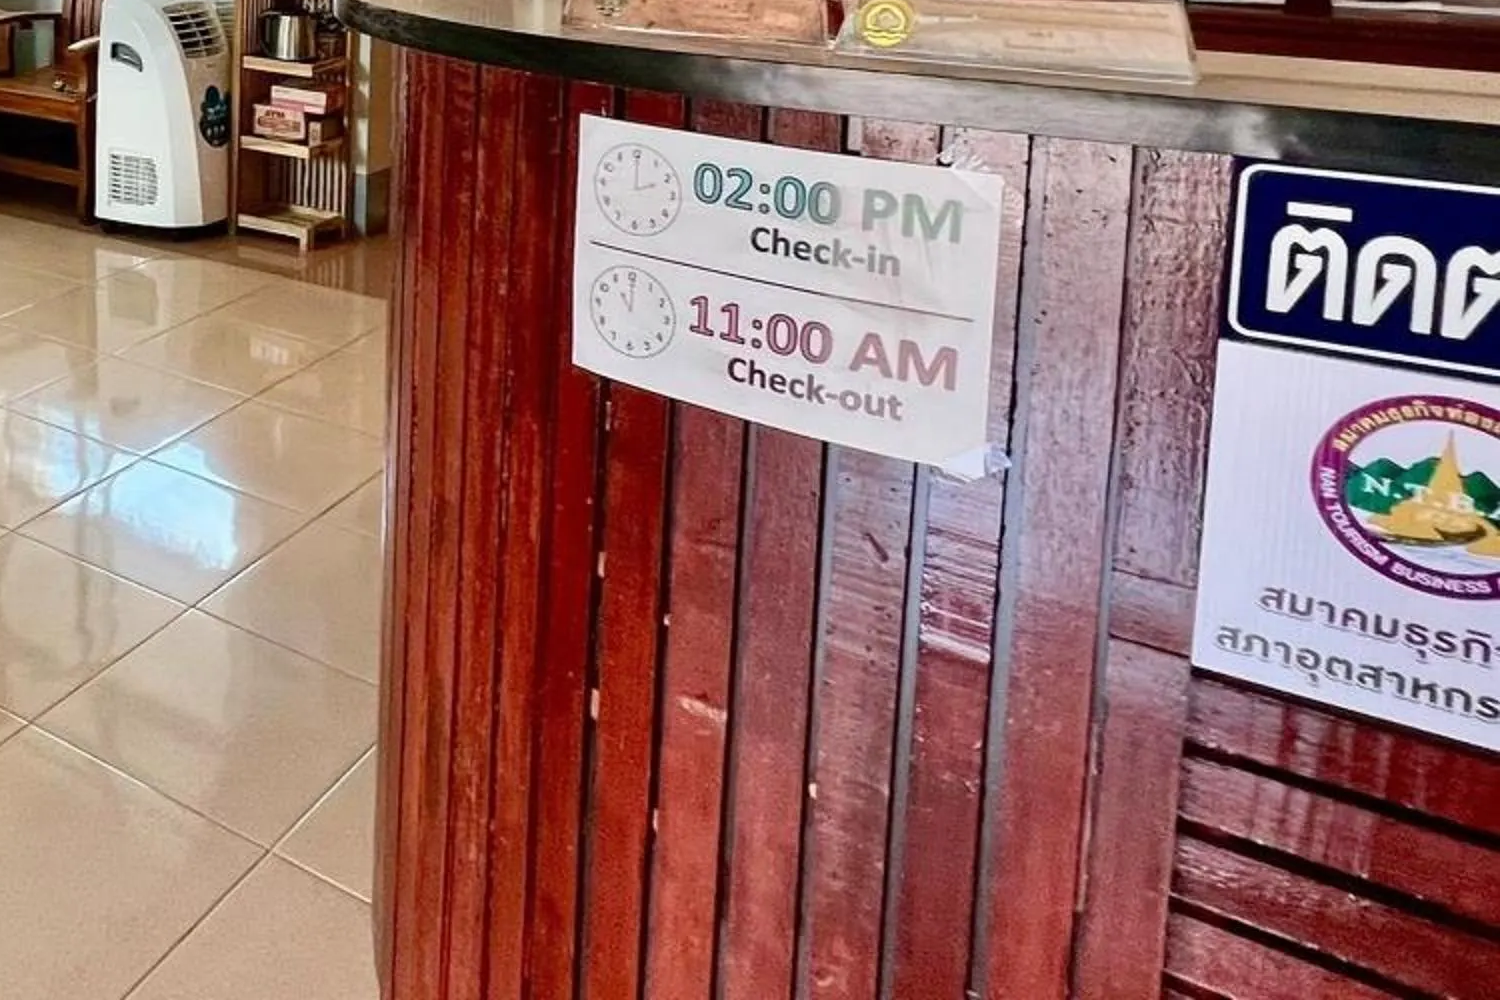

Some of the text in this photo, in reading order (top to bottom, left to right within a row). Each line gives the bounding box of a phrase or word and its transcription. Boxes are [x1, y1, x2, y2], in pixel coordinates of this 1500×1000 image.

[693, 162, 962, 244] 02:00 PM
[750, 225, 901, 277] Check-in
[688, 295, 957, 391] 11:00 AM
[726, 356, 903, 421] Check-out
[1326, 501, 1389, 566] TOURISM
[1390, 560, 1493, 595] BUSINESS
[1260, 587, 1500, 665] สมาคมธุรกิ
